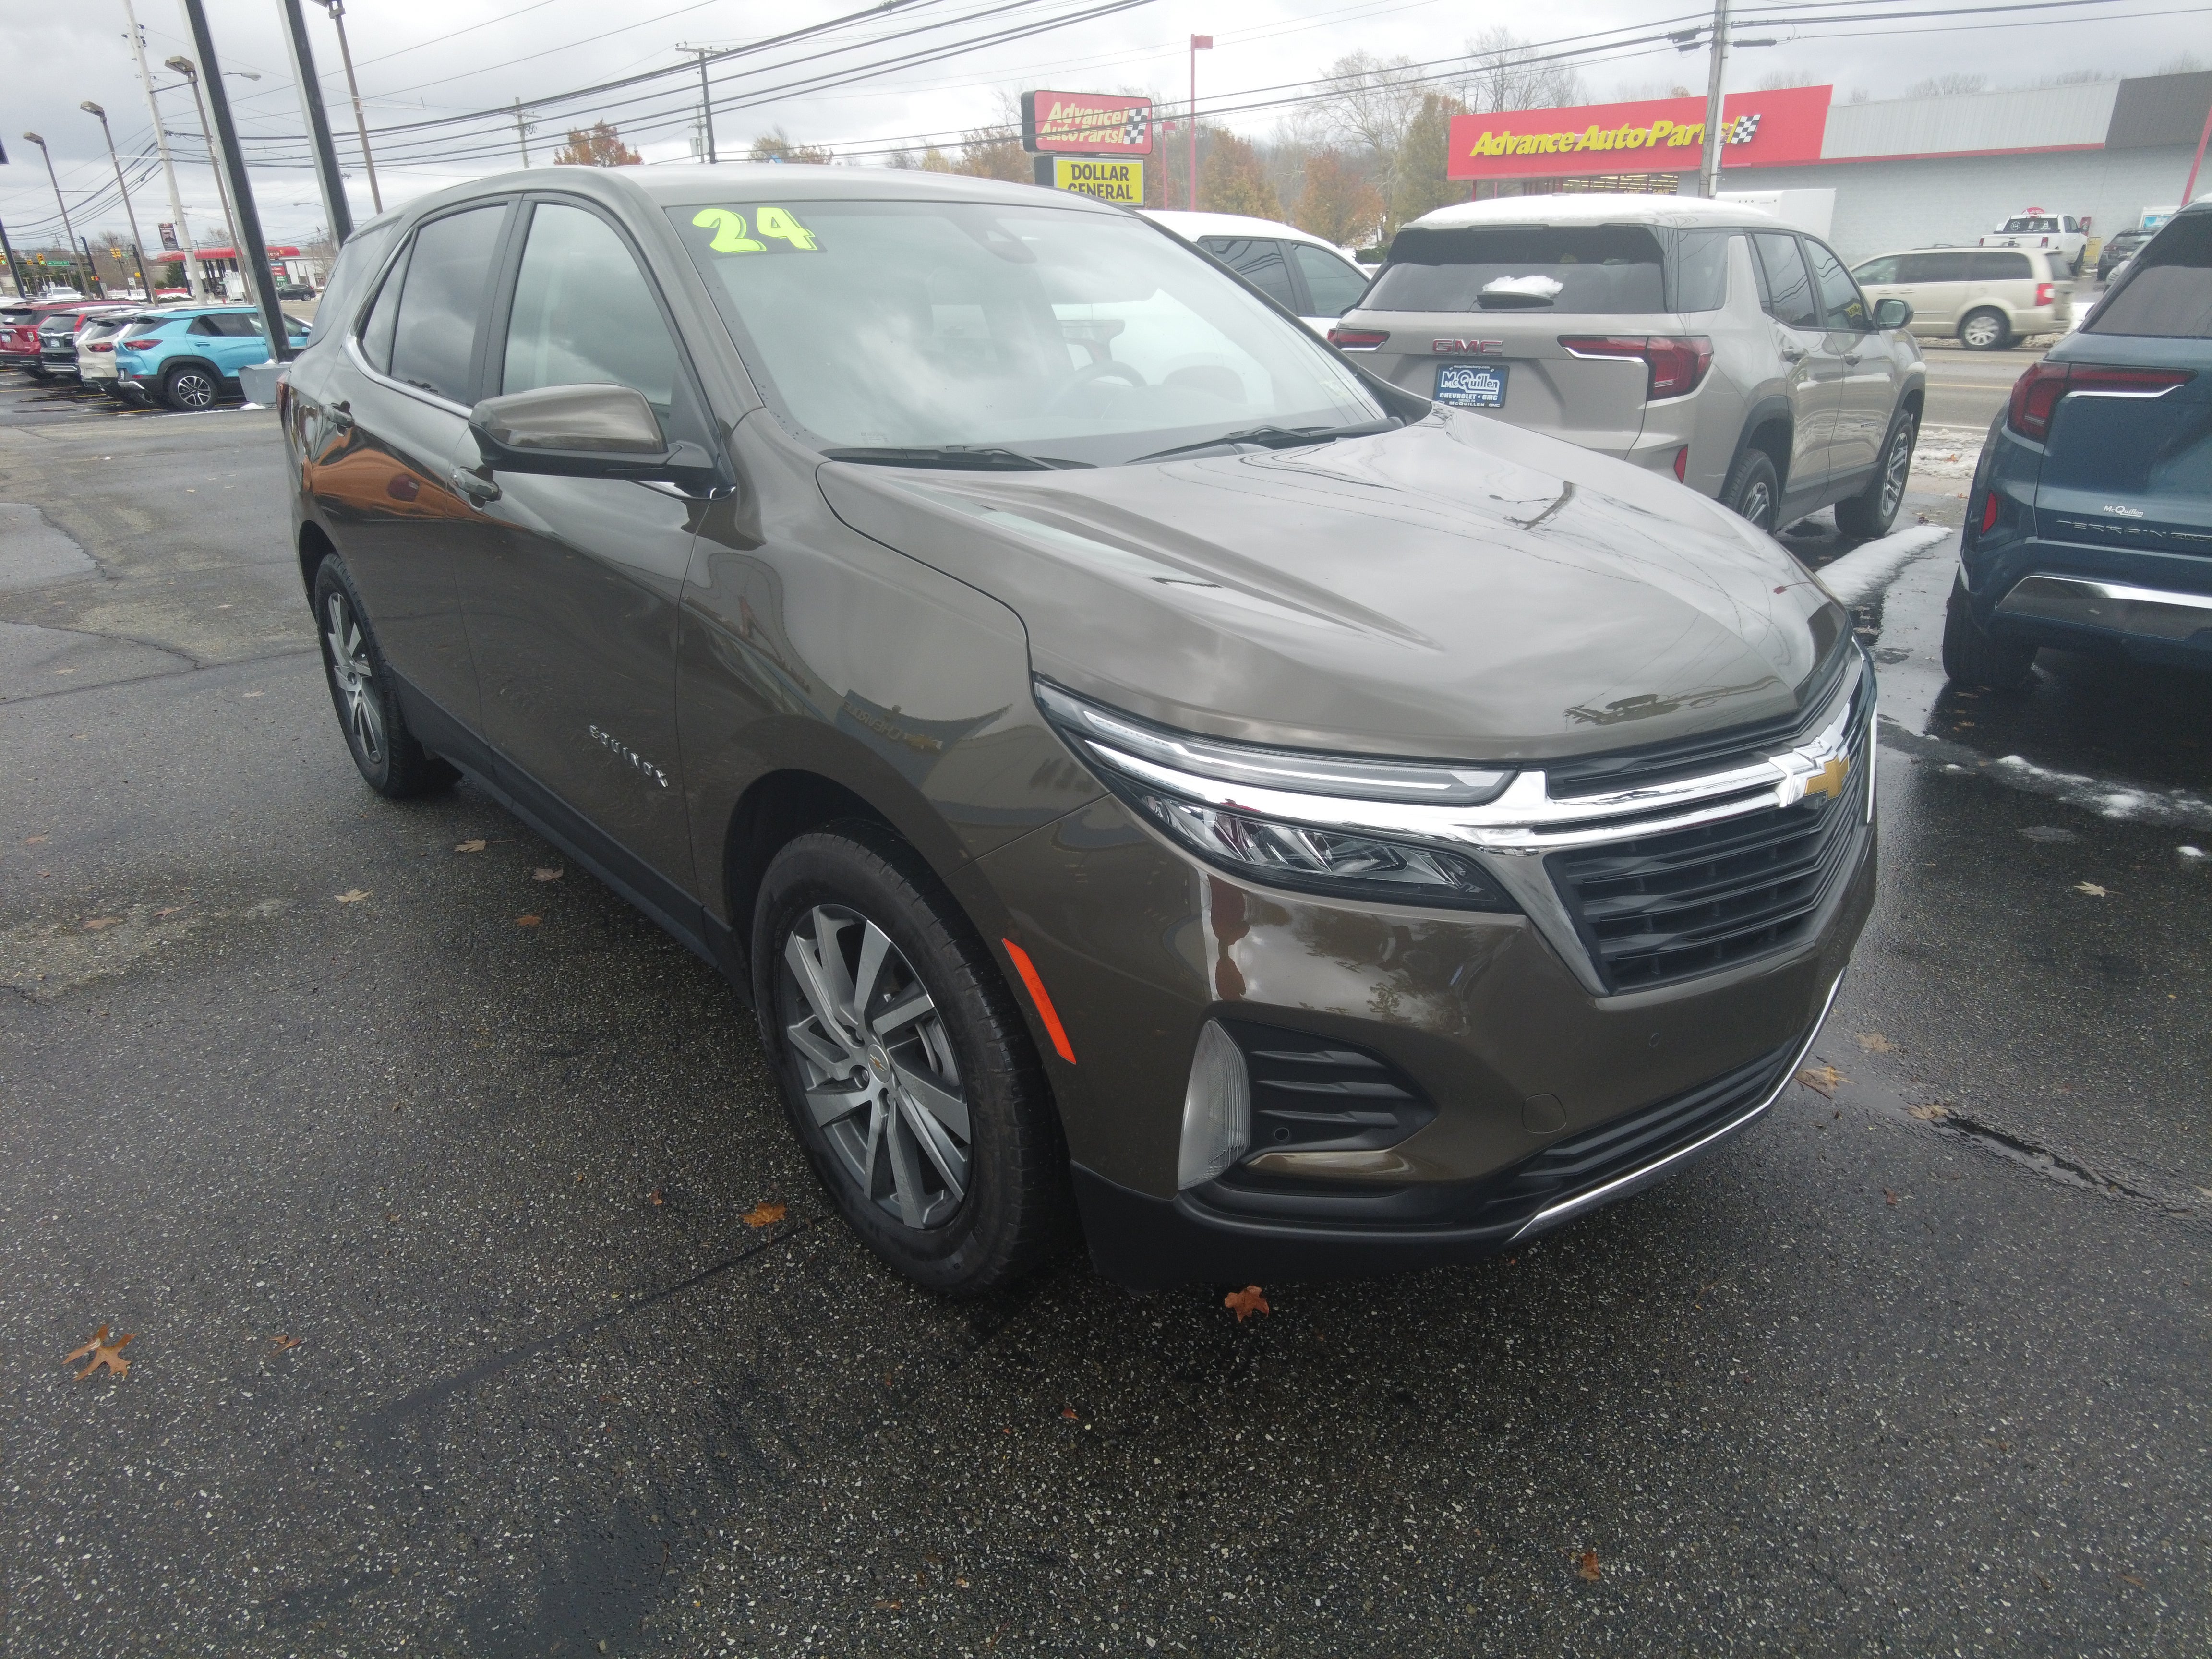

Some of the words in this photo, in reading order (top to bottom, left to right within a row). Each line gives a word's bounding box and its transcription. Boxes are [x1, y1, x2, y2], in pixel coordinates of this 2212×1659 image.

[1037, 122, 1079, 142] Auto
[1469, 131, 1576, 156] Advance
[1573, 124, 1647, 151] Auto
[1070, 164, 1130, 181] DOLLAR
[692, 207, 818, 253] 24
[1432, 339, 1503, 356] GMC
[1441, 370, 1500, 395] McQuillen
[2056, 520, 2167, 537] TERRAIN
[589, 725, 669, 788] EQUINOX
